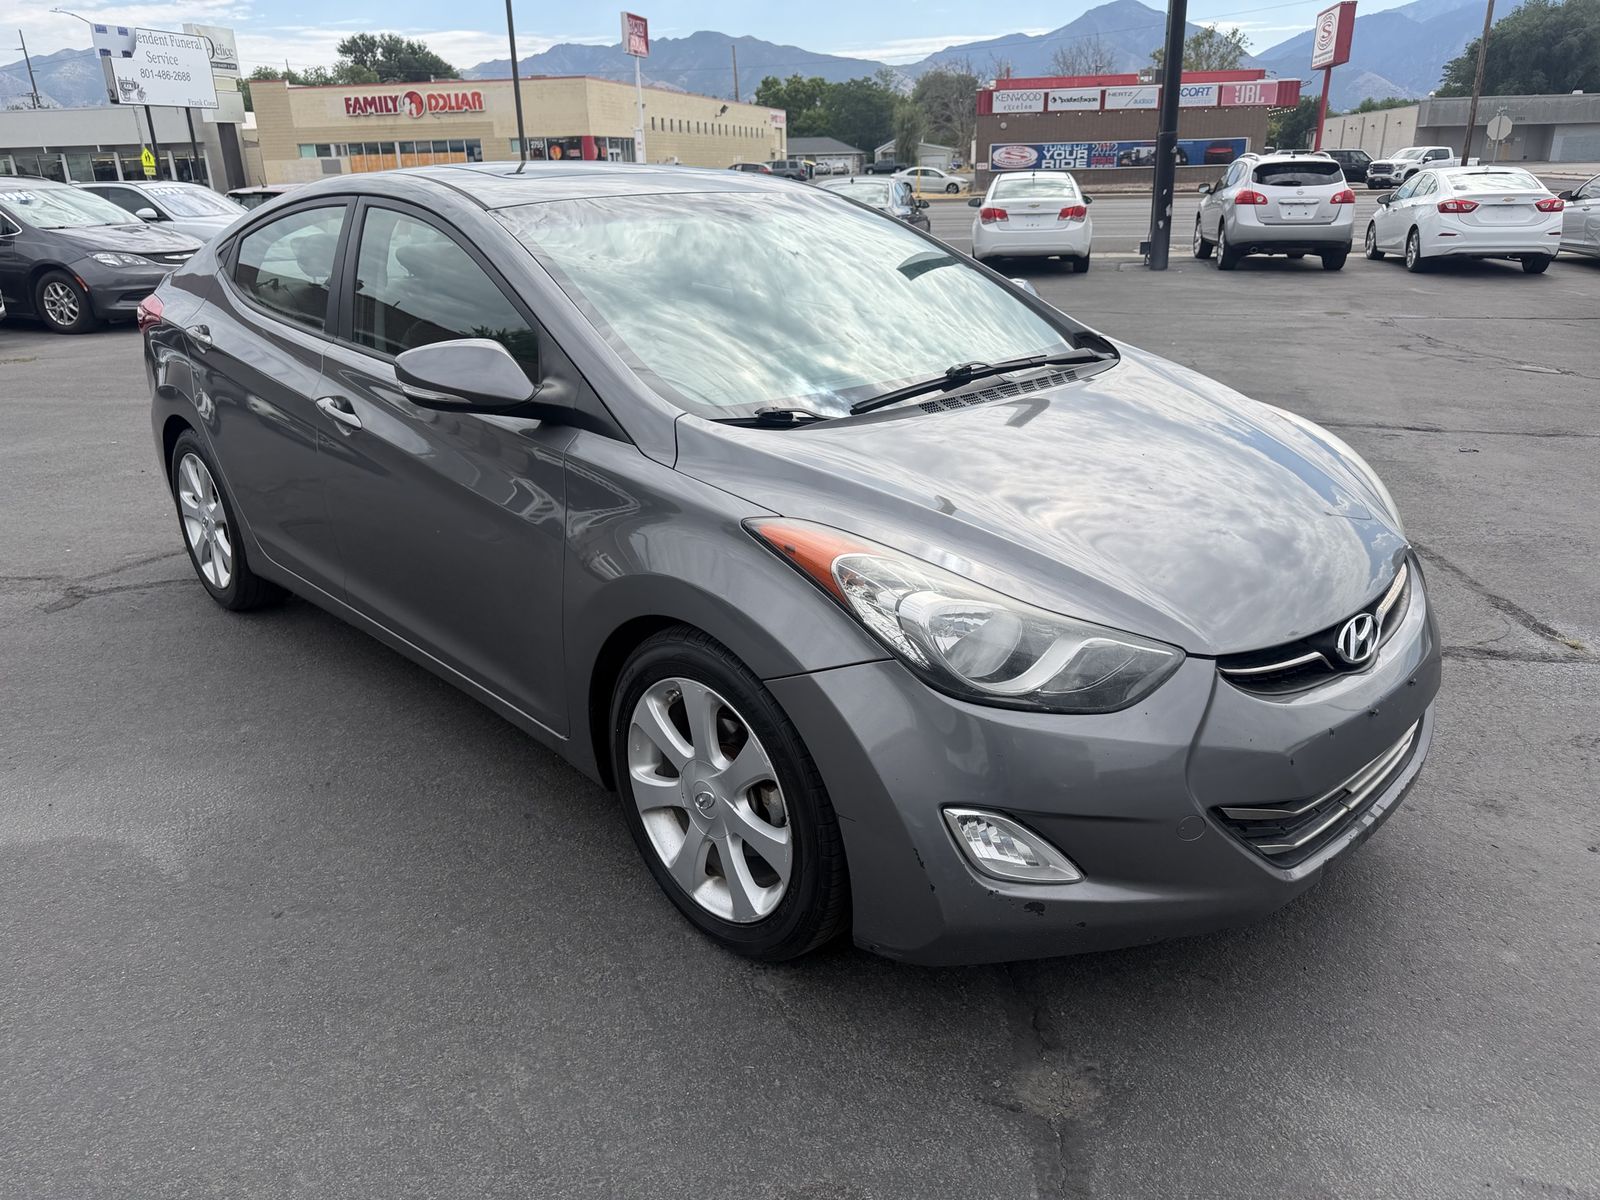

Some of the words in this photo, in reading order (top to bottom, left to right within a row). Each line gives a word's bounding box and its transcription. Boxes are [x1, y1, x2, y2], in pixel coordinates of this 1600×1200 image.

[136, 32, 168, 46] endent
[168, 35, 203, 50] Funeral
[145, 51, 180, 66] Service
[140, 68, 192, 82] 801-486-2688
[995, 92, 1042, 102] KENWOOD
[1178, 87, 1213, 98] CORT
[1234, 85, 1265, 104] JBL
[344, 95, 400, 114] FAMILY
[426, 91, 484, 112] DOLLAR
[1043, 150, 1088, 160] YOUR
[1041, 159, 1088, 169] RIDE
